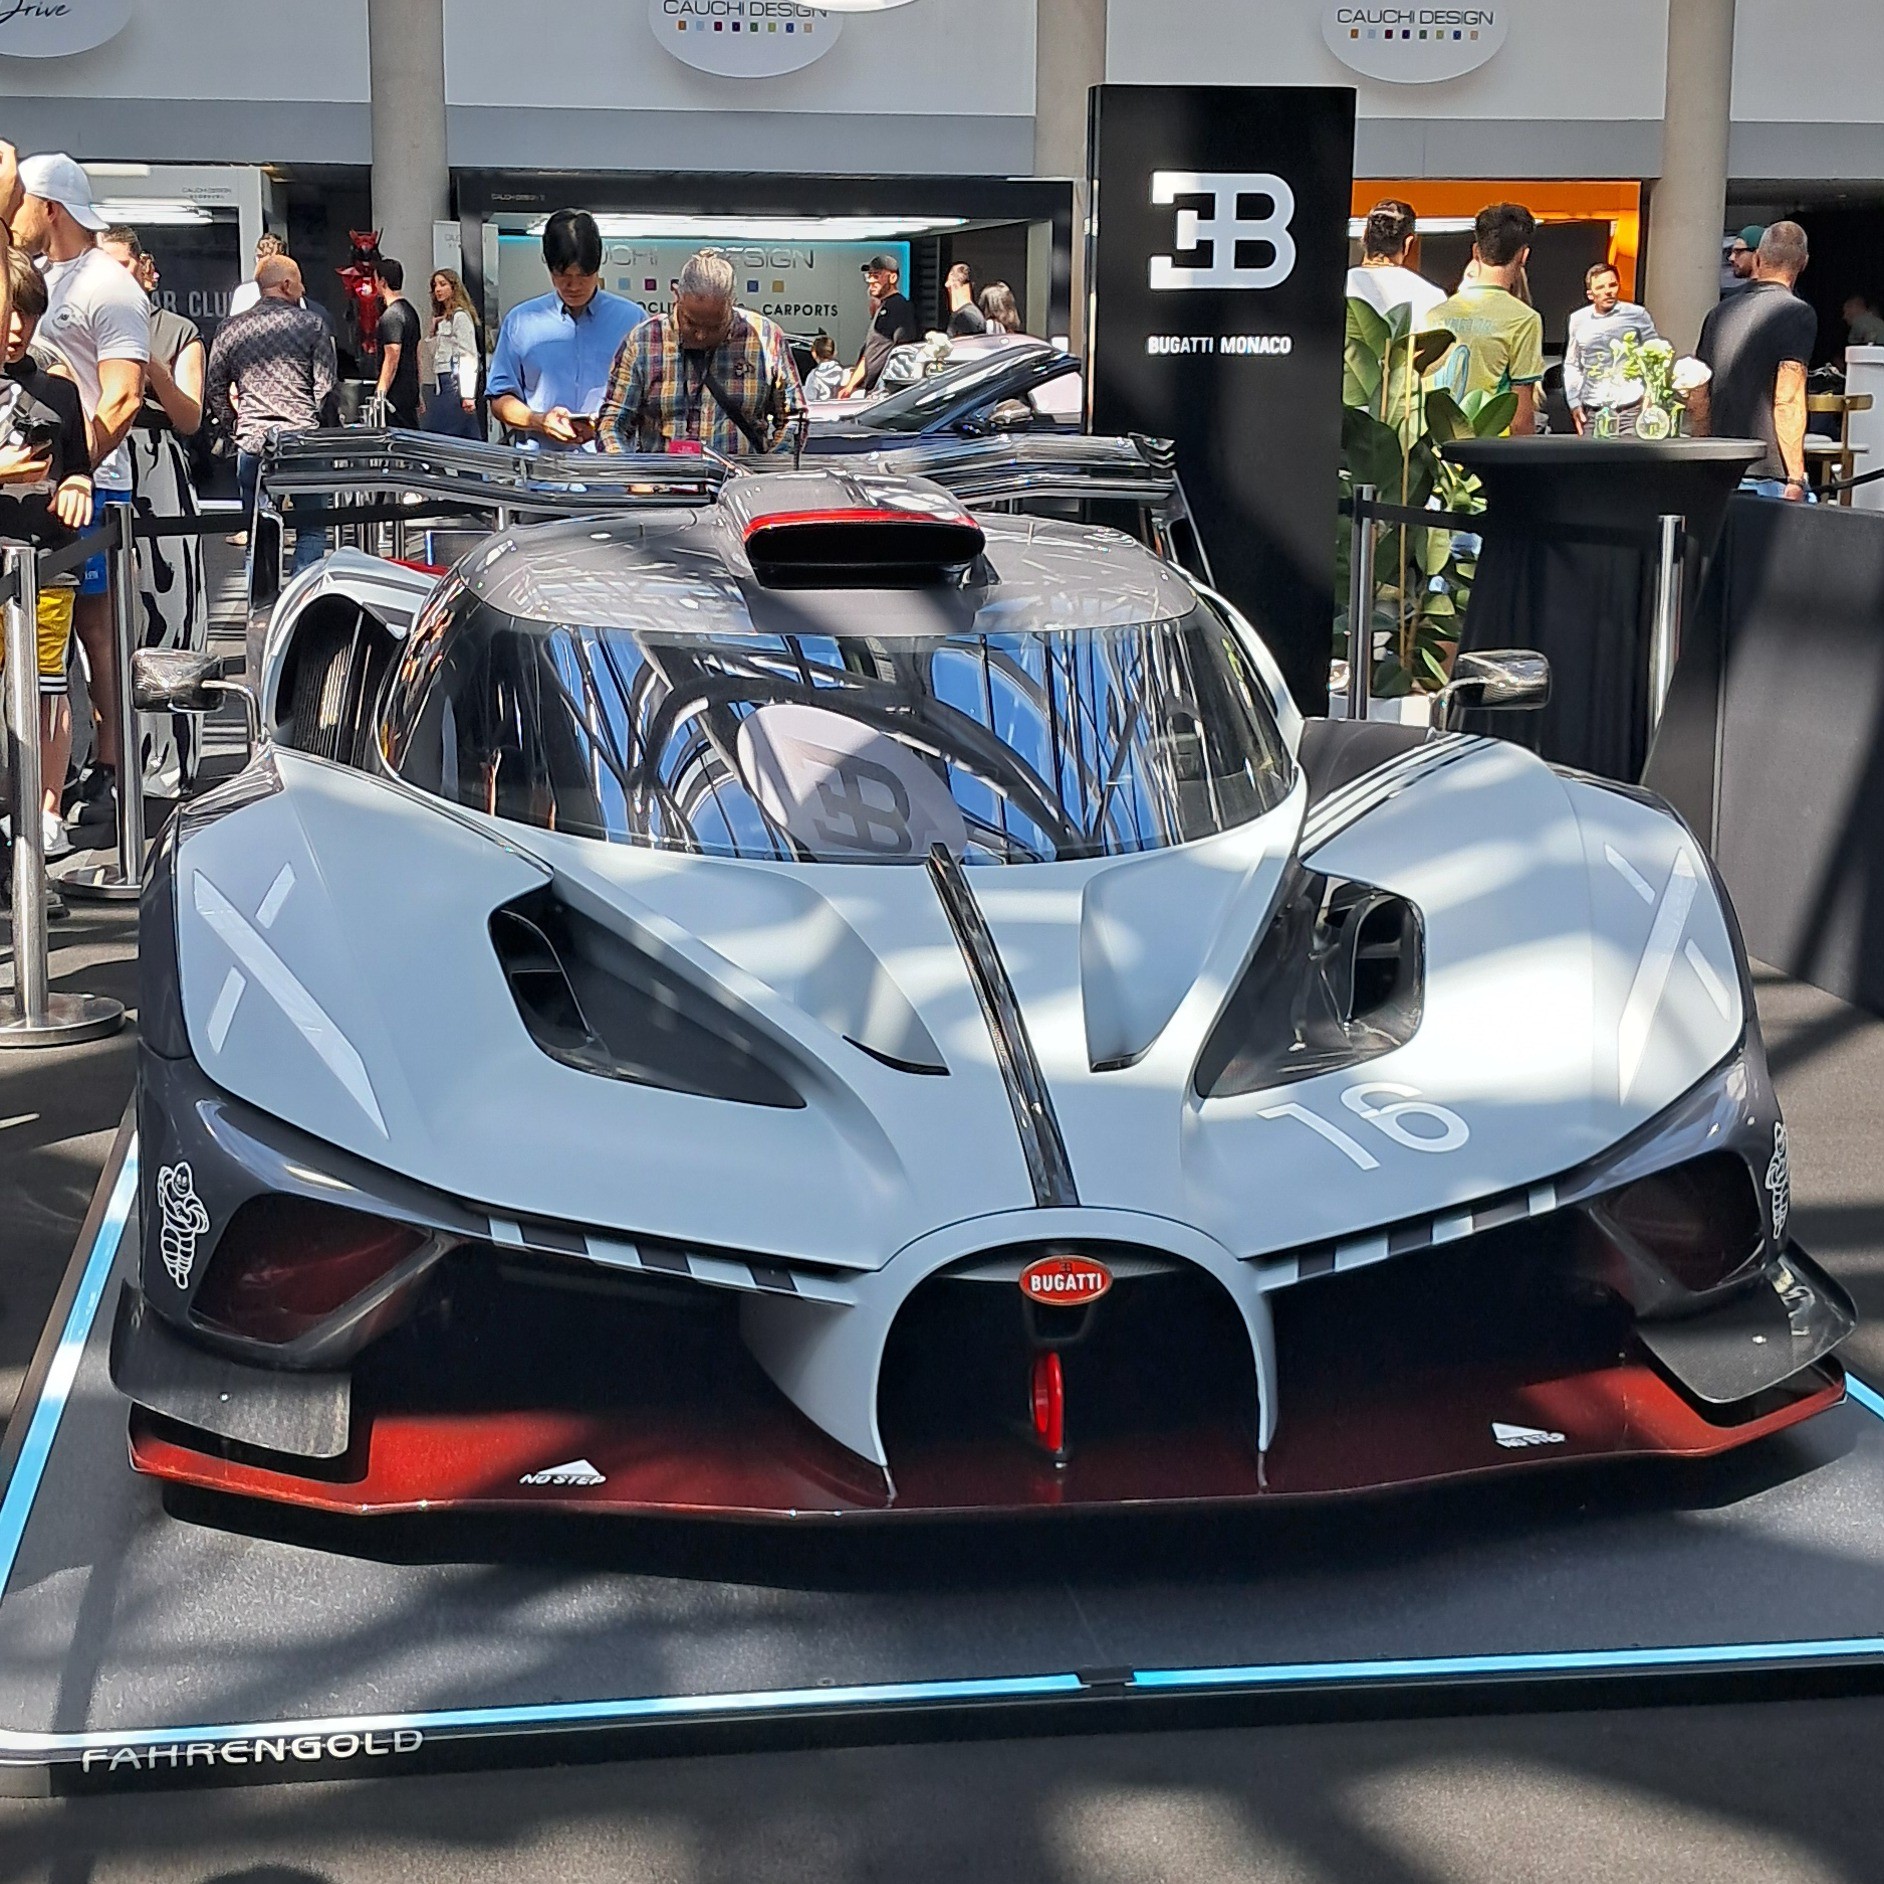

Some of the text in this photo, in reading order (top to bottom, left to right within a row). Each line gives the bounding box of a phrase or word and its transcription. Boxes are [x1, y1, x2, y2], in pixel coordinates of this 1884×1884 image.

[663, 0, 745, 15] CAUCHI
[1337, 8, 1495, 25] CAUCHI DESIGN
[188, 291, 232, 319] CLU
[762, 303, 839, 317] CARPORTS
[1148, 336, 1292, 354] BUGATTI MONACO
[1255, 1081, 1471, 1172] 16
[1030, 1272, 1103, 1292] BUGATTI
[519, 1473, 607, 1486] NO STEP
[82, 1729, 424, 1773] FAHRENGOLD
